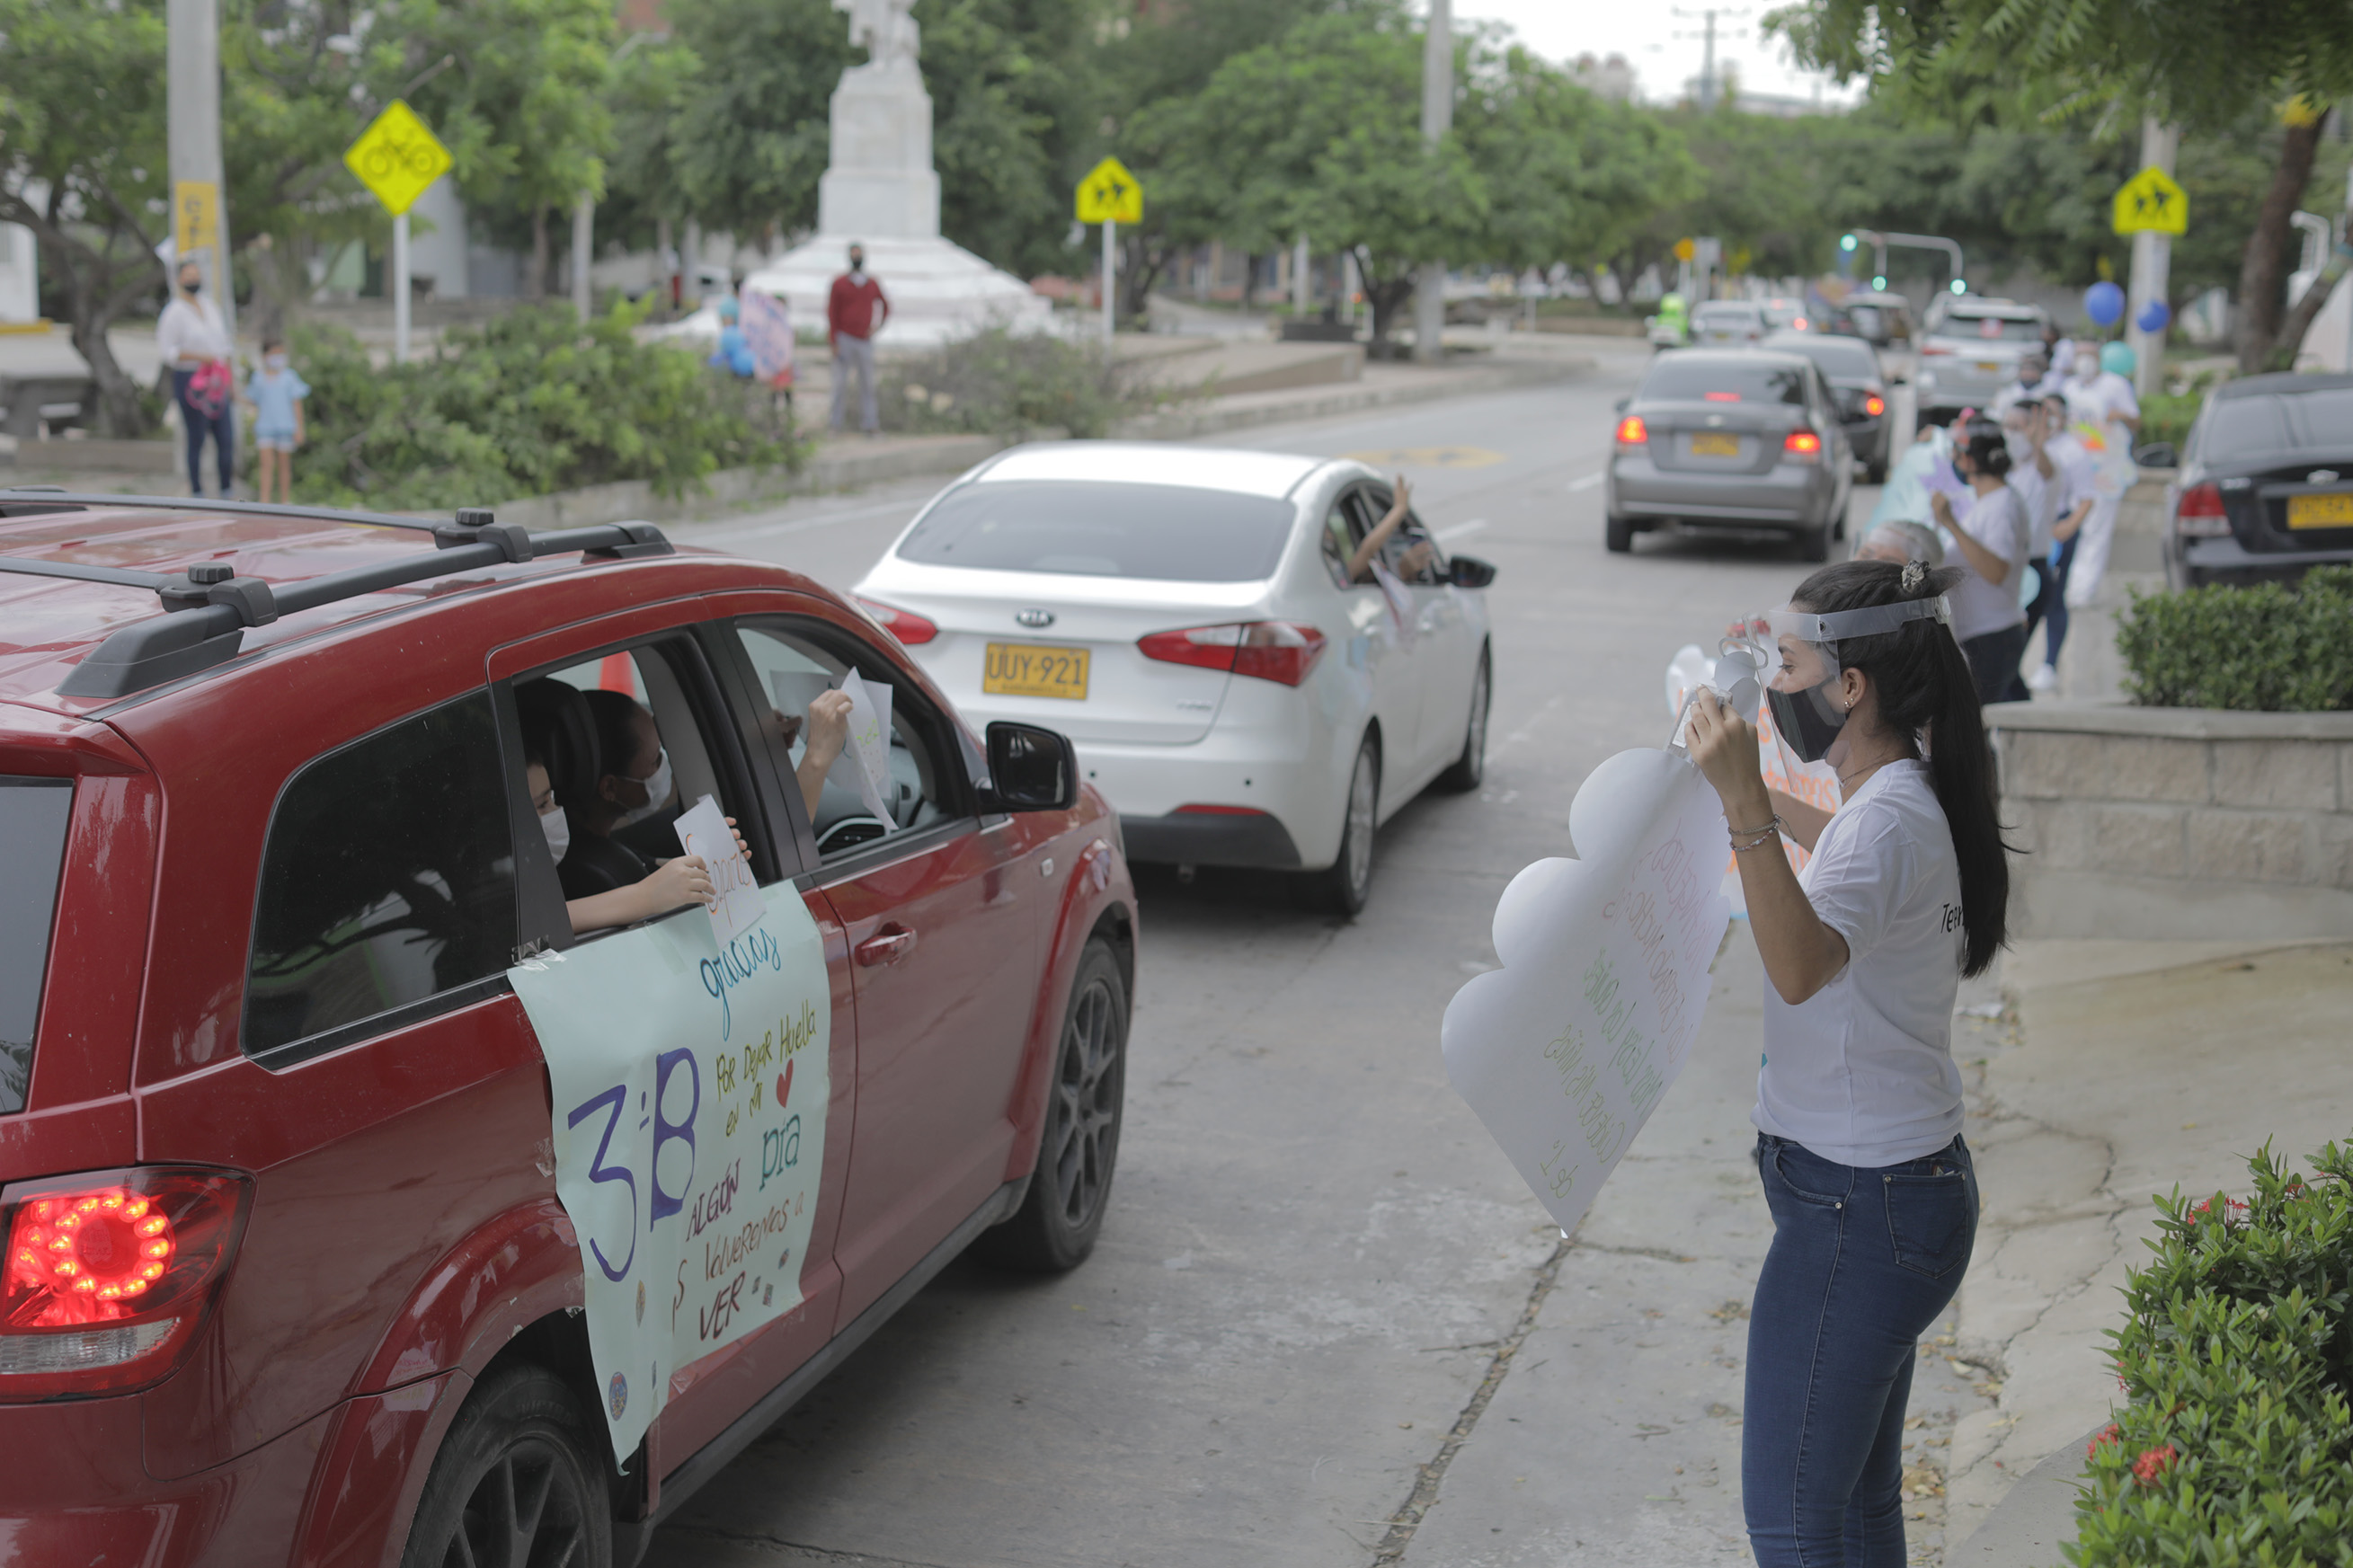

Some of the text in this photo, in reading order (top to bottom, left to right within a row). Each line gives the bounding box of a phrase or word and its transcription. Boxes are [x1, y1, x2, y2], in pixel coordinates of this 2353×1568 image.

[1017, 610, 1051, 625] KIA
[699, 927, 781, 1041] gracias
[700, 1271, 745, 1341] VER
